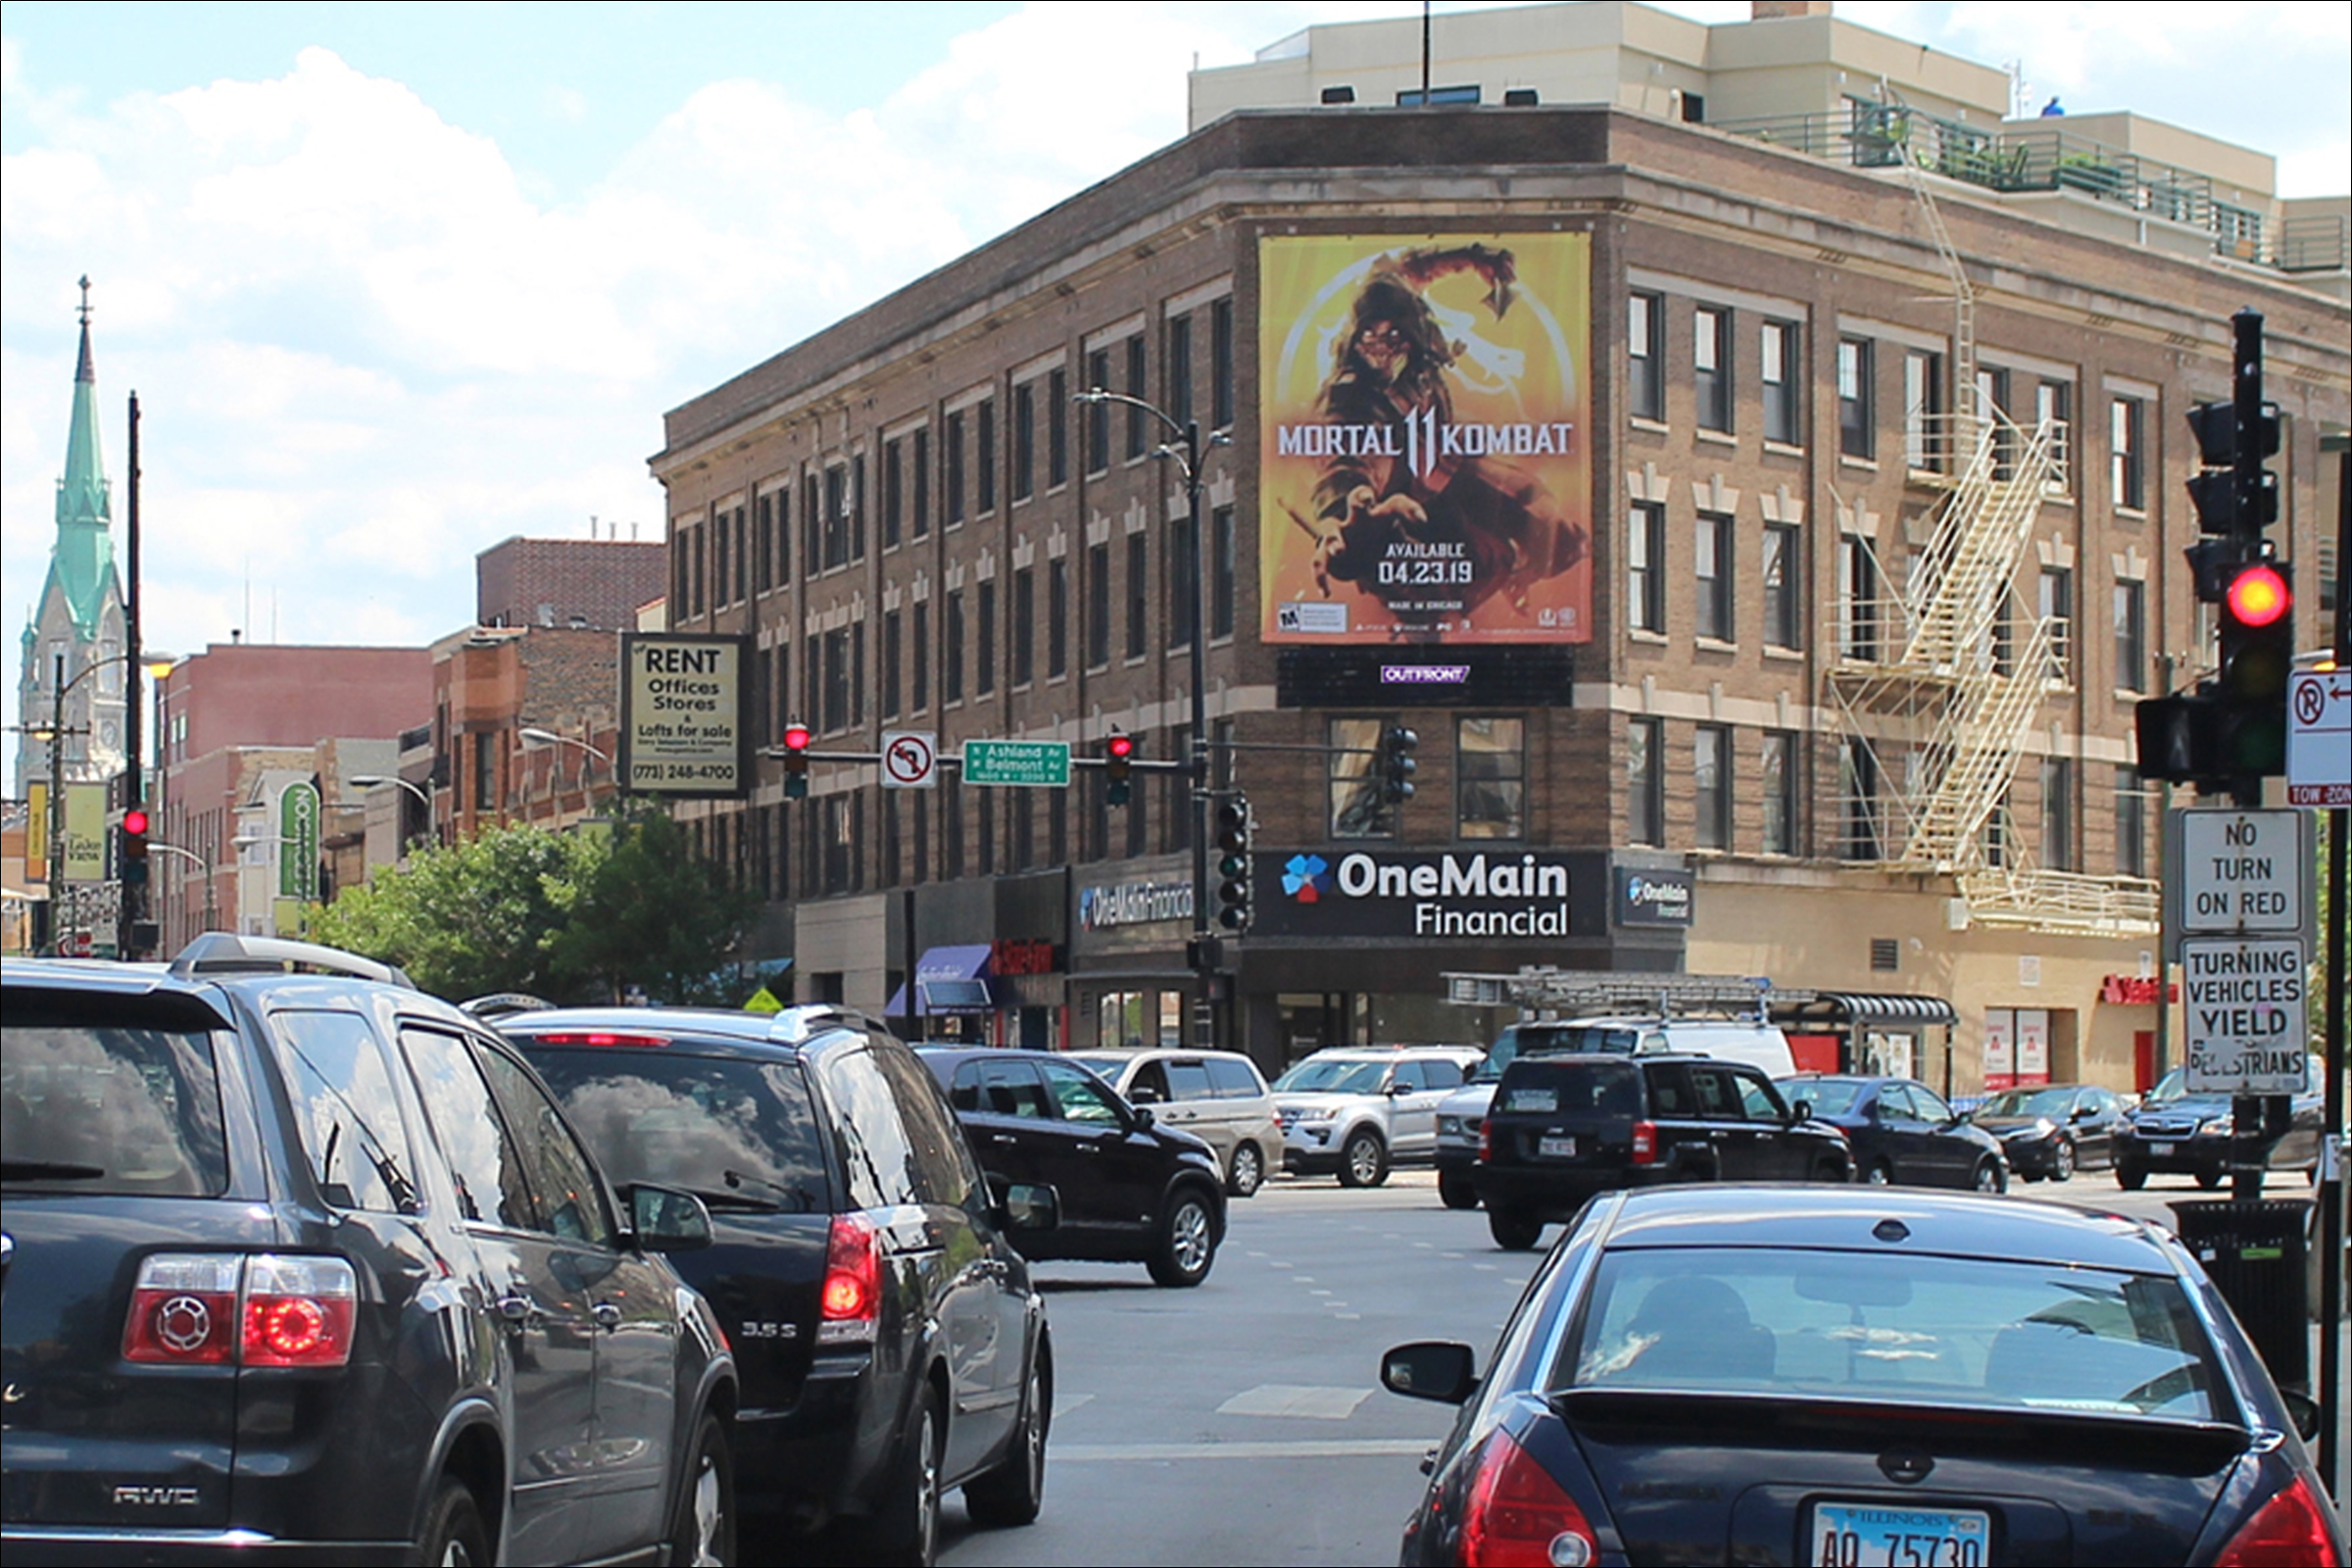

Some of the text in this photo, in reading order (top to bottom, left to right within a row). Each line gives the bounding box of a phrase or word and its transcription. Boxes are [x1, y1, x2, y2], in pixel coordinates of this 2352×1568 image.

[1278, 404, 1574, 478] MORTAL 11 KOMBAT
[1386, 543, 1465, 558] AVAILABLE
[1378, 562, 1472, 584] 04.23.19
[646, 648, 721, 674] RENT
[648, 678, 721, 695] Offices
[654, 695, 716, 711] Stores
[638, 724, 733, 738] Lofts for sale
[987, 745, 1042, 759] Ashland
[633, 763, 735, 781] (773) 248-4700
[985, 758, 1044, 772] Belmont
[2226, 824, 2257, 847] NO
[1338, 853, 1568, 899] OneMain
[2212, 858, 2272, 880] TURN
[2196, 892, 2286, 915] ON RED
[1416, 903, 1568, 936] Financial
[2189, 951, 2297, 975] TURNING
[2188, 979, 2300, 1003] VEHICLES
[2200, 1008, 2287, 1037] YIELD
[1860, 1510, 1943, 1527] ILLINOIS
